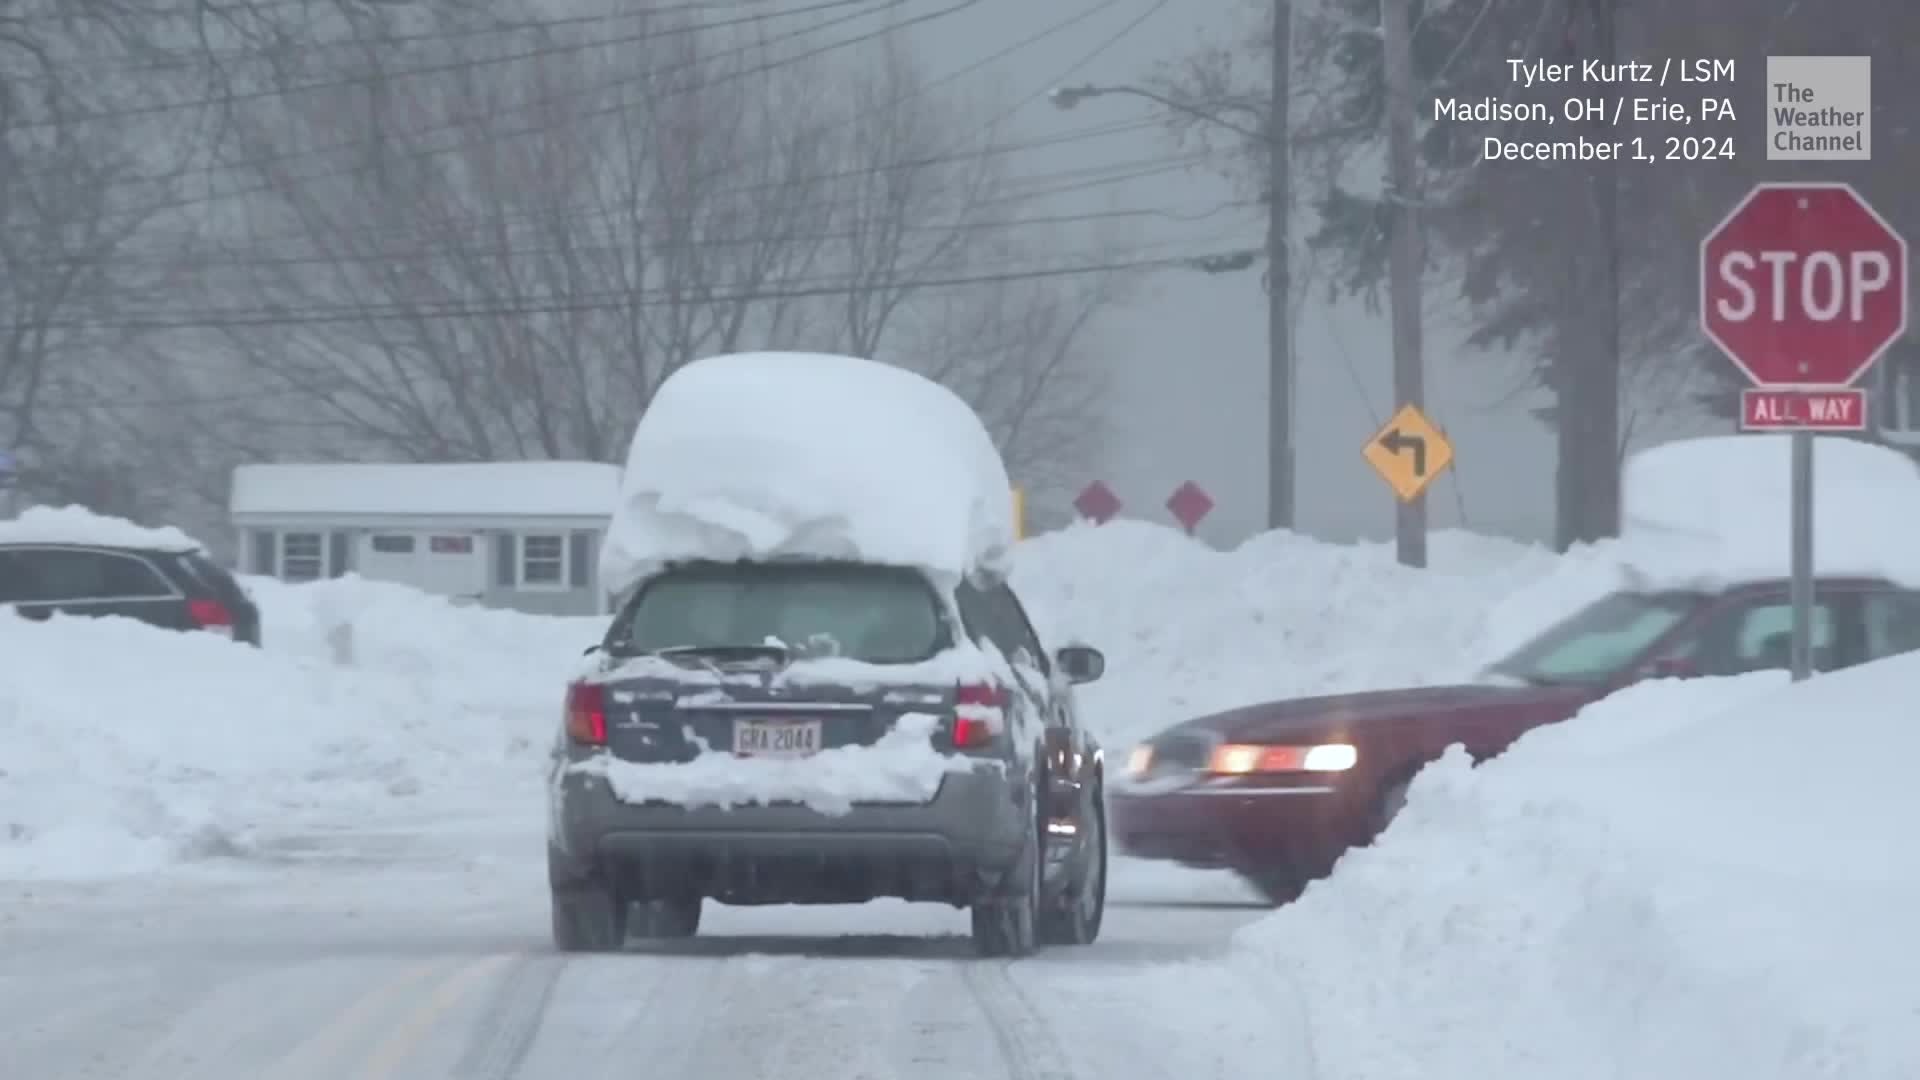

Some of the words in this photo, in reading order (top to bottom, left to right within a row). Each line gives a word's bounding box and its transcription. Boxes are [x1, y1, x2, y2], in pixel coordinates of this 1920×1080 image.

[1717, 251, 1891, 322] STOP
[1754, 397, 1799, 421] ALL
[1807, 397, 1853, 421] WAY
